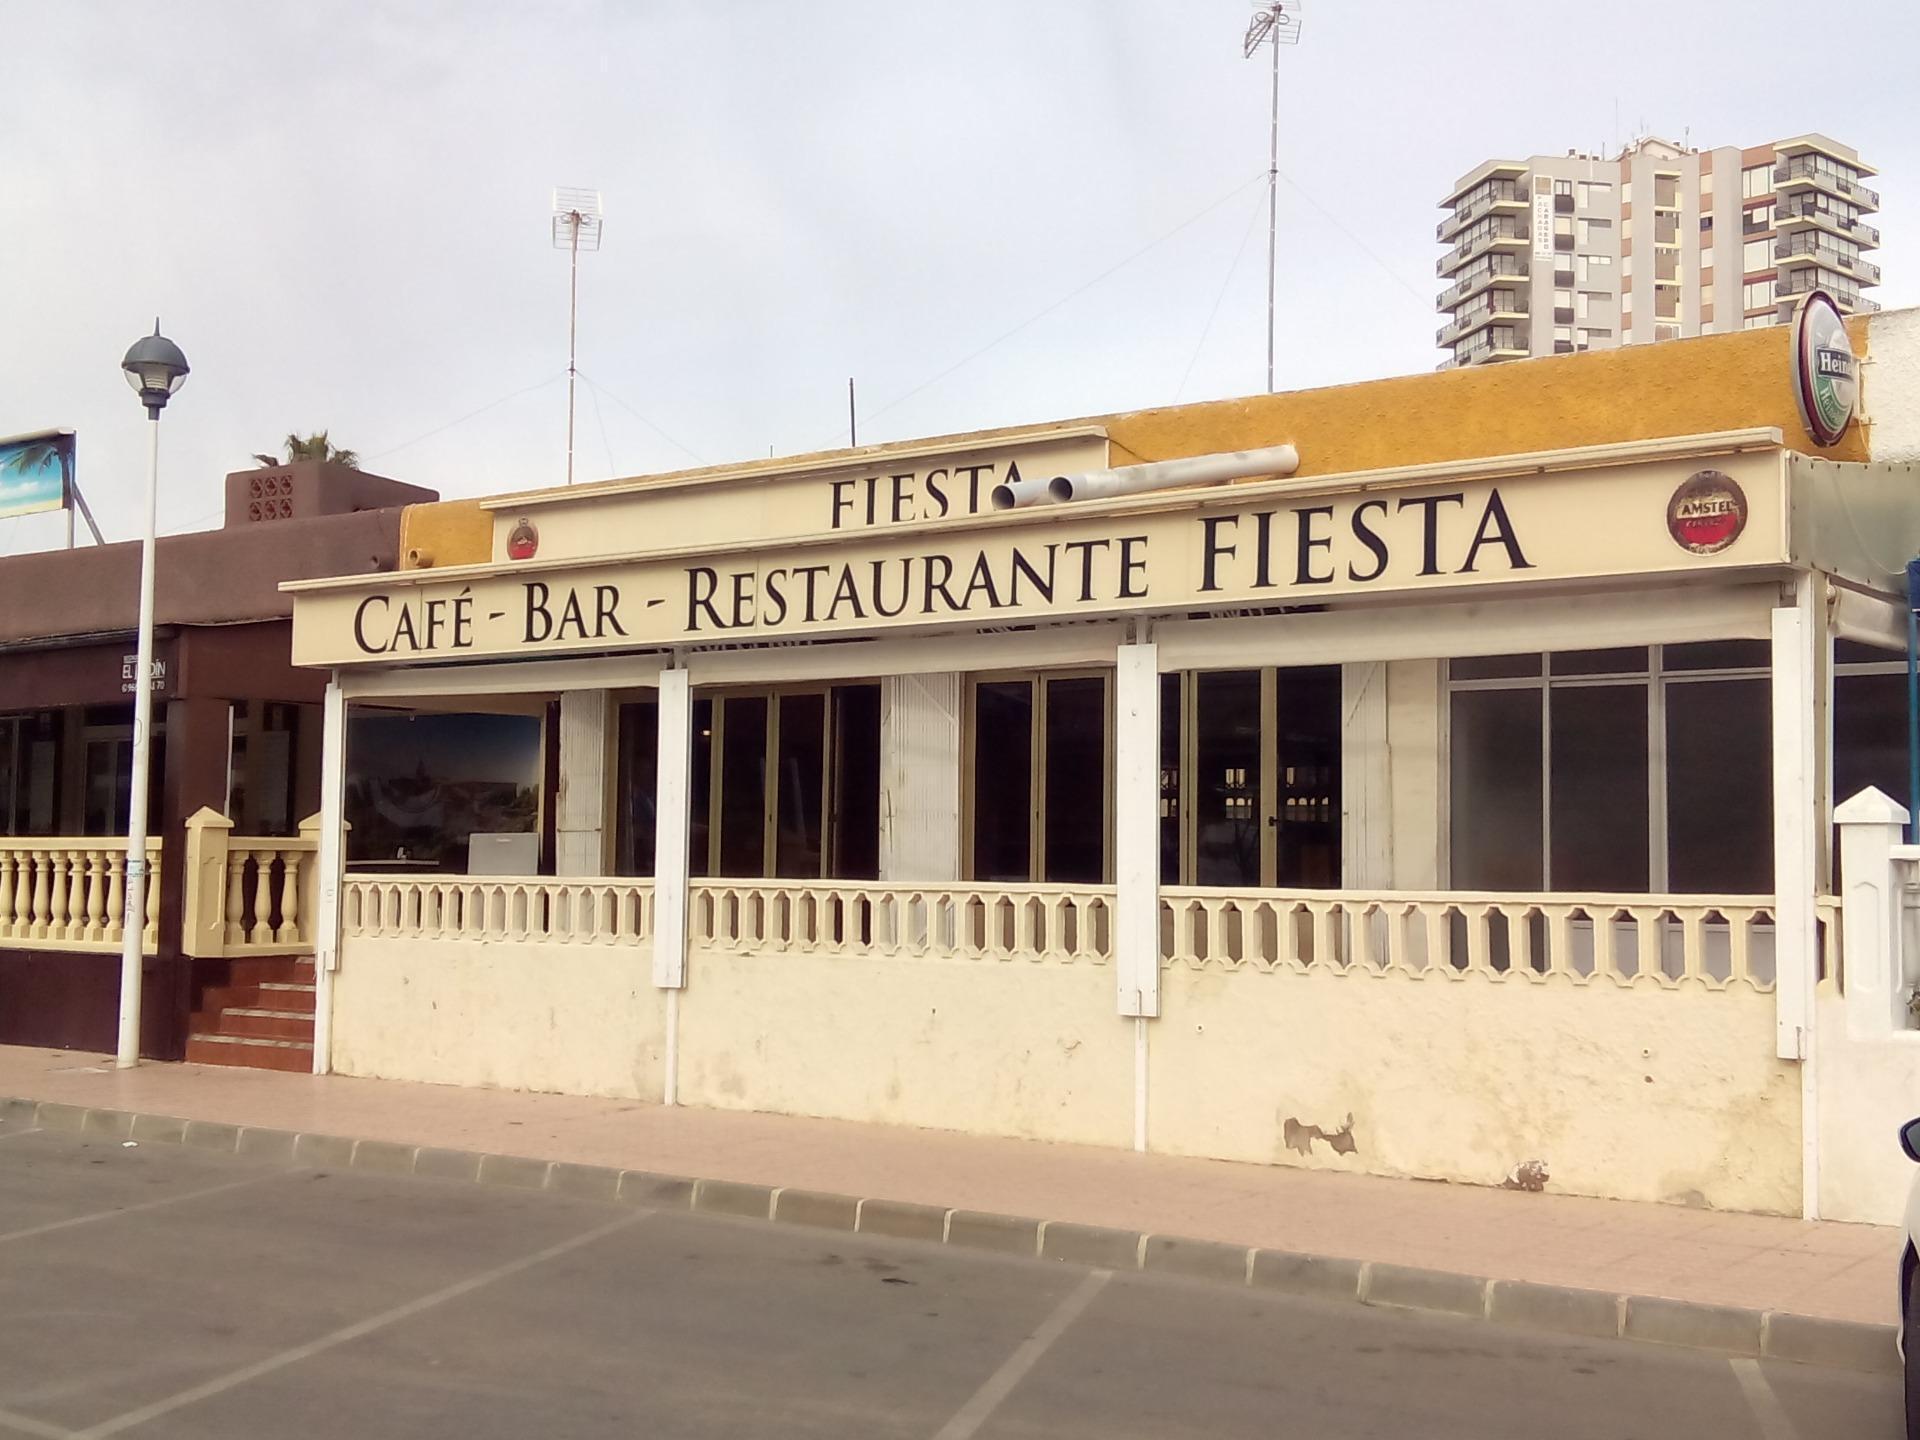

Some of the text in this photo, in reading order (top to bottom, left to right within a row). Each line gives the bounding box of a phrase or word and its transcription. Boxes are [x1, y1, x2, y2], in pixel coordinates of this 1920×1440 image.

[1681, 500, 1734, 516] AMSTEL
[353, 586, 474, 655] CAFÉ
[521, 581, 630, 644] BAR
[683, 535, 1150, 632] RESTAURANTE
[1196, 487, 1538, 592] FIESTA
